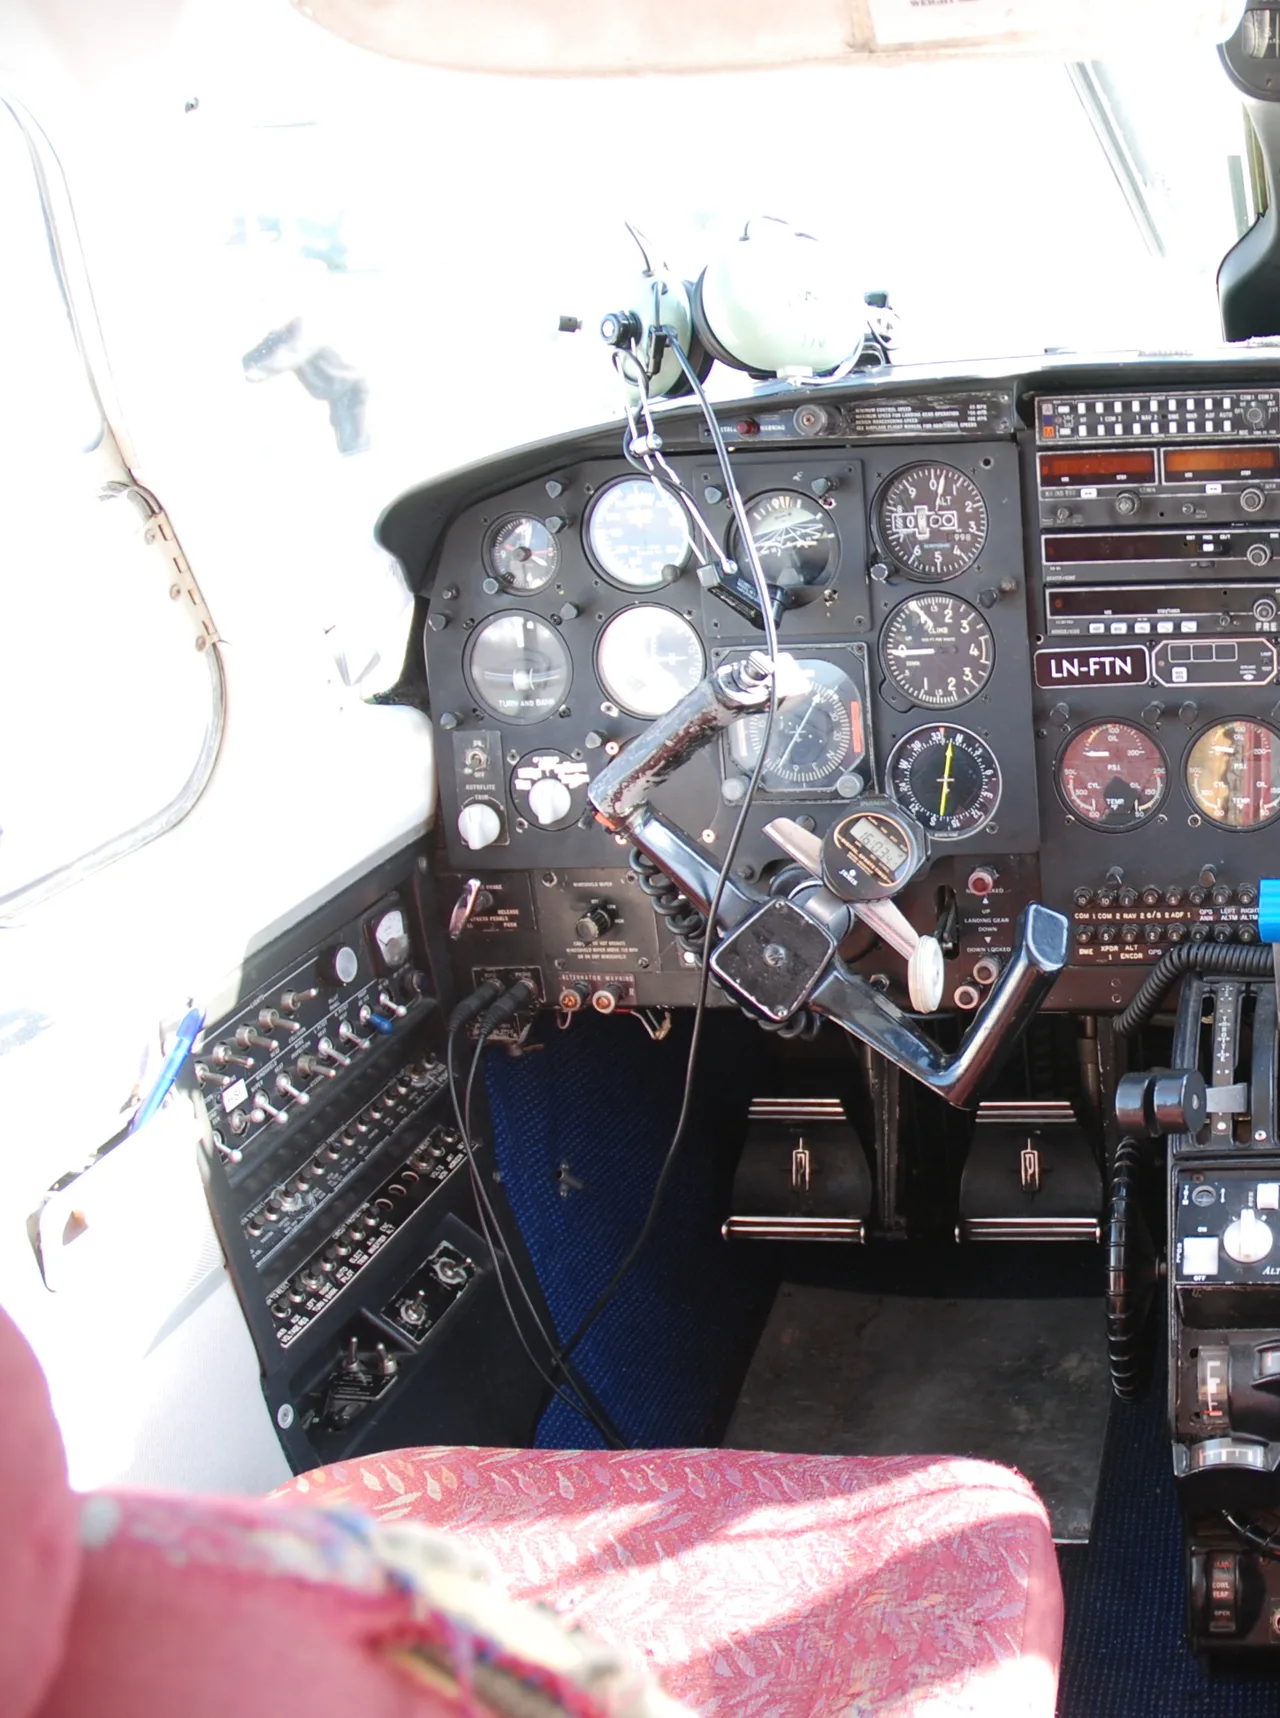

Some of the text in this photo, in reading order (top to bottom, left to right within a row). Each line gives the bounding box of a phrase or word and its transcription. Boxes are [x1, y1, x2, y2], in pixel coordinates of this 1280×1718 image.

[944, 610, 953, 622] 2
[960, 620, 969, 633] 3
[1256, 623, 1277, 631] FRE
[969, 645, 979, 656] 4
[1050, 657, 1132, 678] LN-FTN
[963, 668, 972, 680] 3
[924, 678, 928, 689] 1
[948, 678, 956, 690] 2
